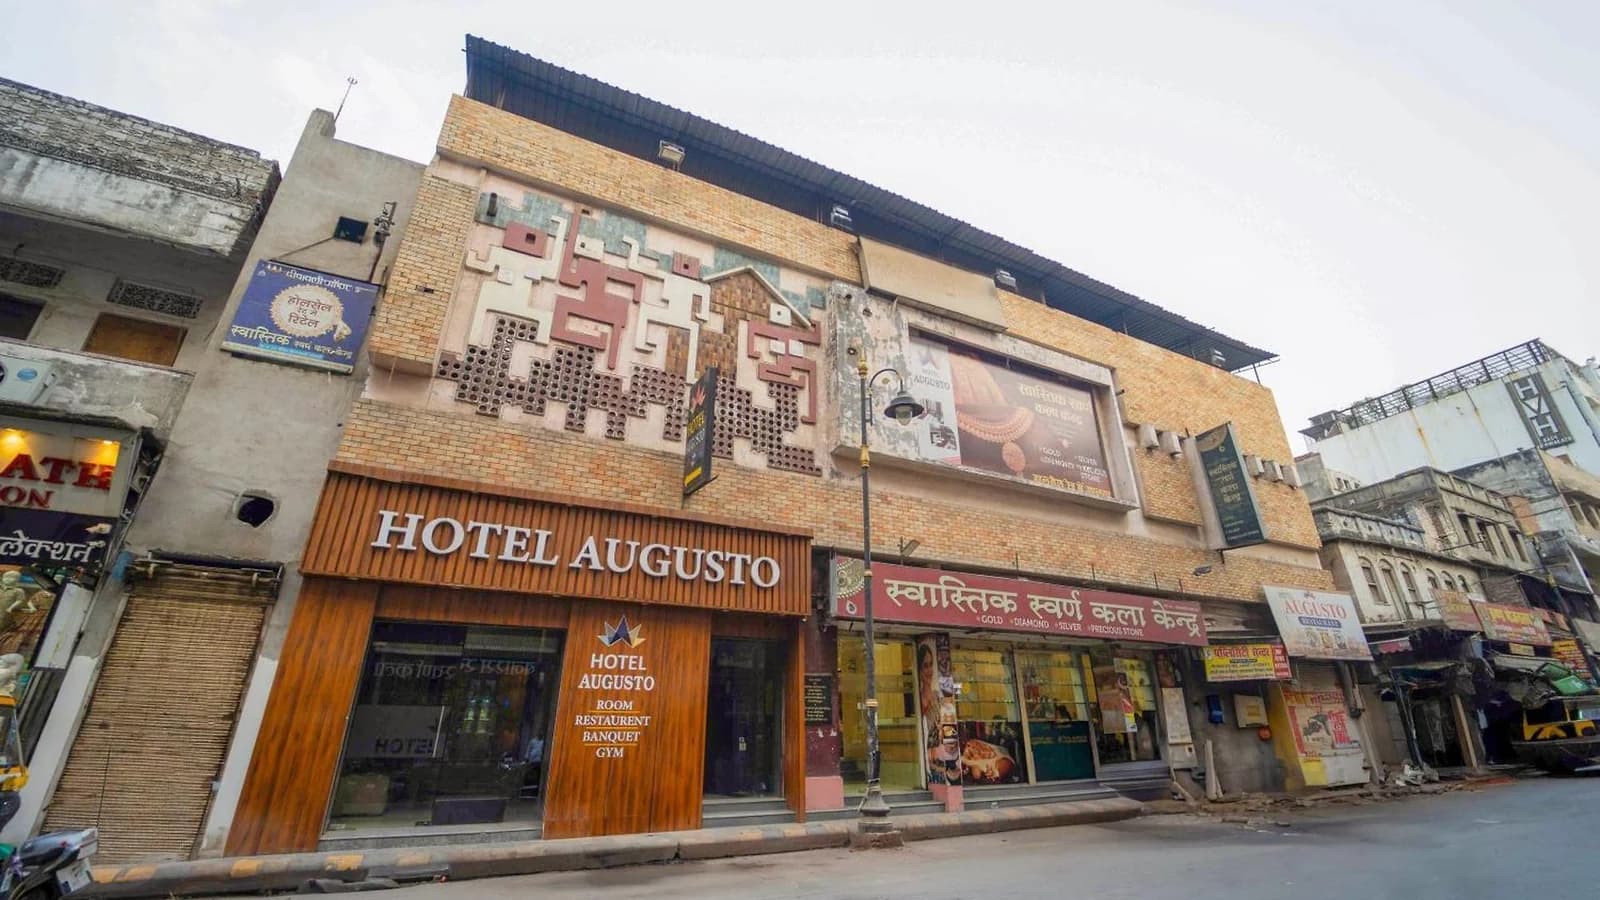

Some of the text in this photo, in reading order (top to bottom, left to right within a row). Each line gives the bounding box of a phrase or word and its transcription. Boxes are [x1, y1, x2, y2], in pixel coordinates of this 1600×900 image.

[287, 294, 333, 312] होलसेल
[288, 311, 320, 328] रिटेल
[231, 324, 292, 346] स्वास्तिक
[371, 510, 781, 589] HOTEL AUGUSTO
[883, 575, 1202, 638] स्वास्तिक स्वर्ण कला केन्द्र
[1285, 600, 1347, 619] AUGUSTO
[981, 615, 1003, 625] GOLD
[1013, 617, 1050, 629] DIAMOND
[1058, 621, 1082, 632] SILVER
[590, 653, 647, 671] HOTEL
[577, 673, 655, 692] AUGUSTO
[596, 699, 634, 711] ROOM
[574, 714, 651, 727] RESTAURENT
[582, 730, 641, 744] BANQUET
[596, 746, 625, 758] GYM
